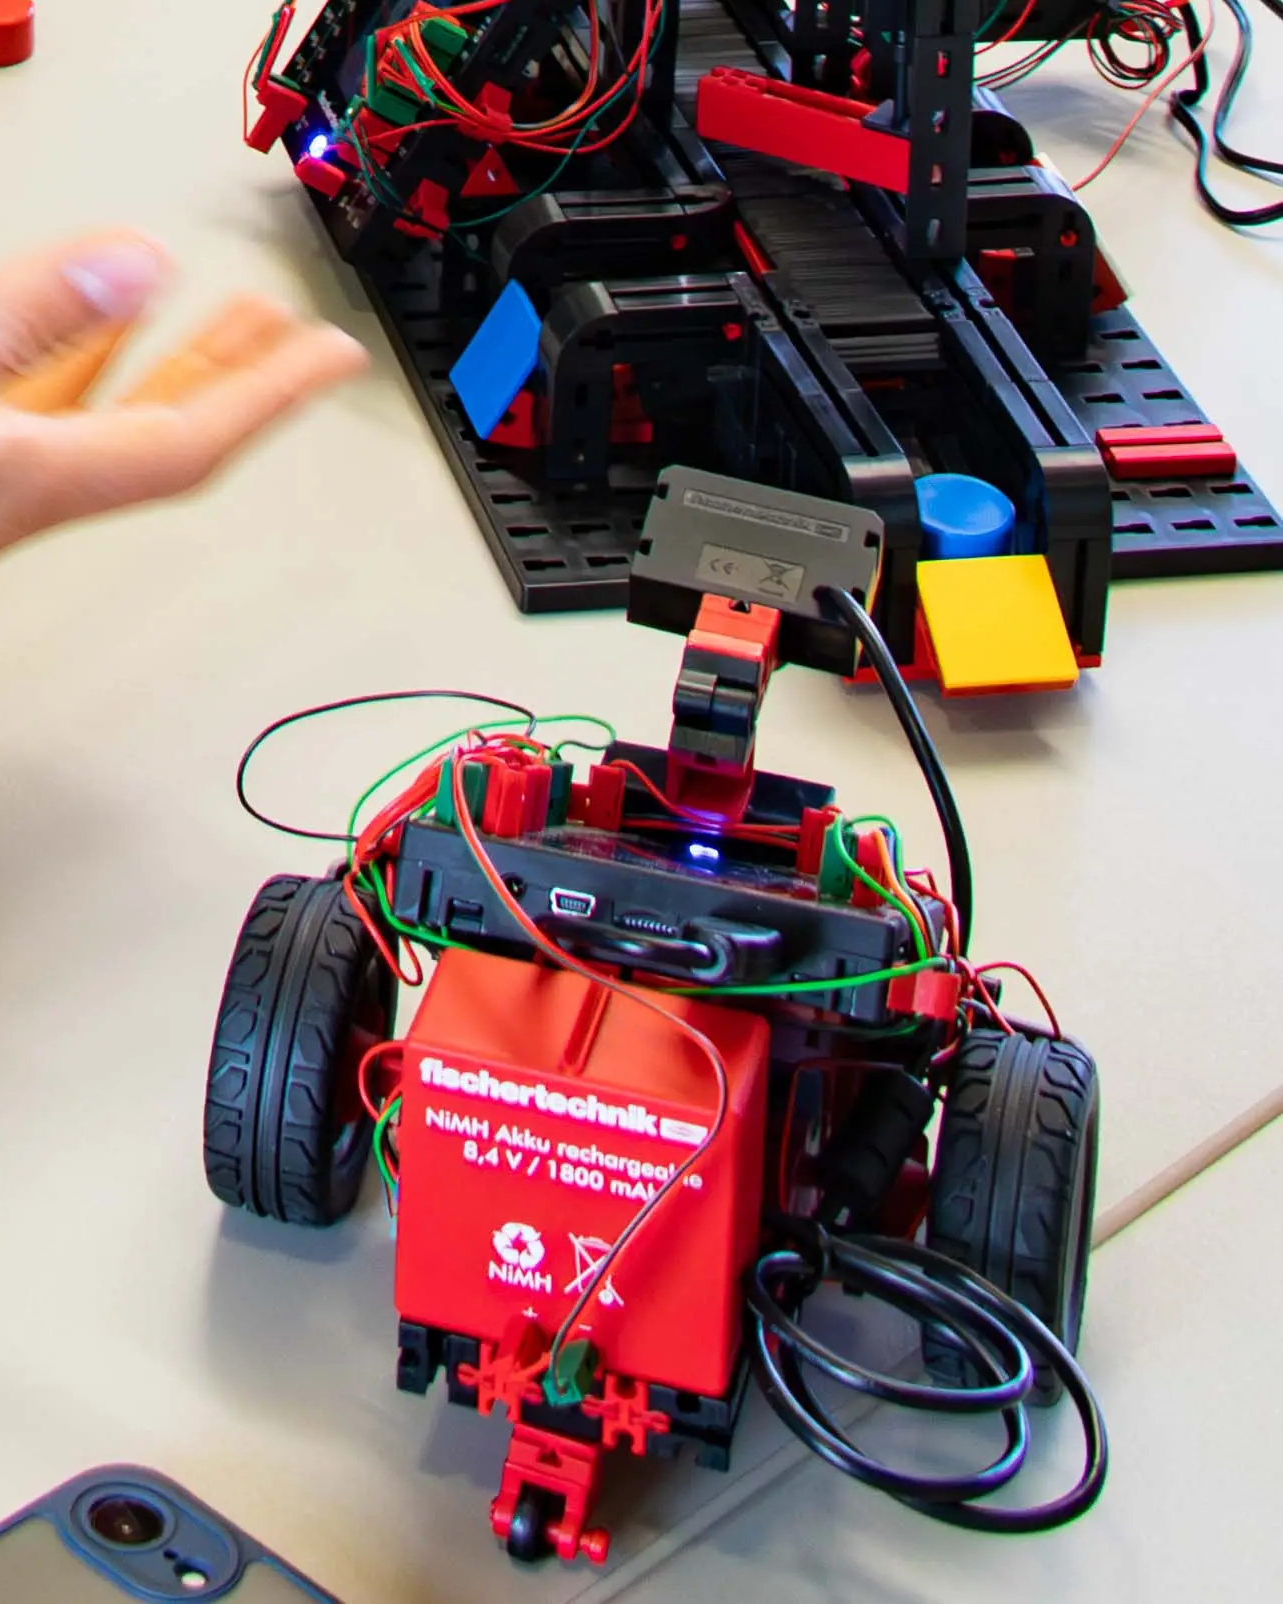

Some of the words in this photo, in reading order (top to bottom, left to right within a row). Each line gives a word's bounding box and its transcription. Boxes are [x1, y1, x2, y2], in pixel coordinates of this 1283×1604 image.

[418, 1056, 659, 1138] fischertechnik
[425, 1106, 489, 1140] NiMH
[495, 1123, 551, 1154] Akku
[463, 1140, 500, 1168] 8,4
[505, 1150, 524, 1171] V
[547, 1159, 605, 1192] 1800
[488, 1260, 552, 1295] NiMH
